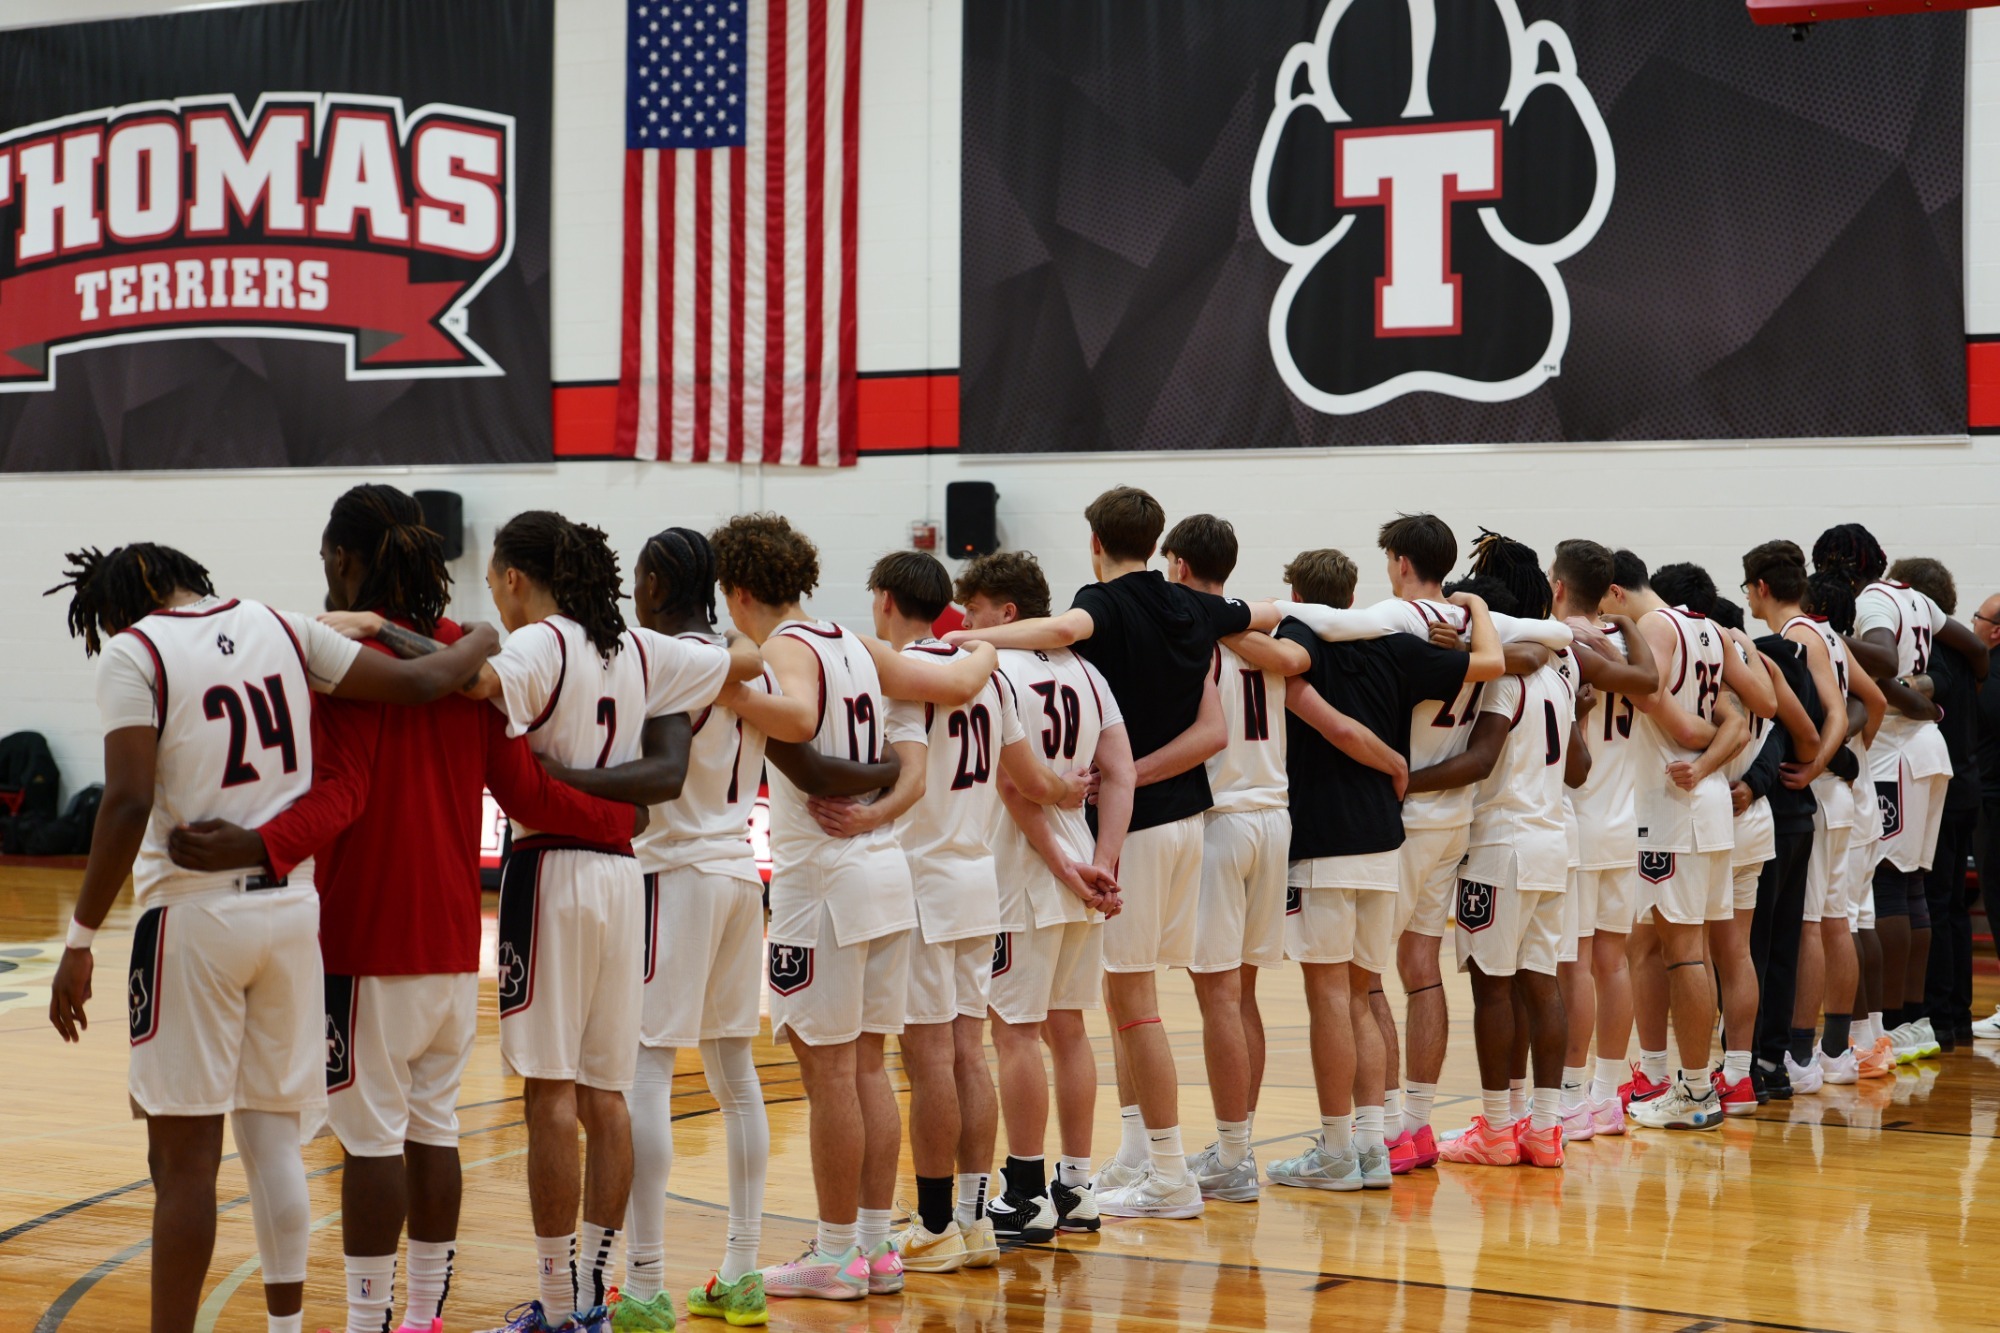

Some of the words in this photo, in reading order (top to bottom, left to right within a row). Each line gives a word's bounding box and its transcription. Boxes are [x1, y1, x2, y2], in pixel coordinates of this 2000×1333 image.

[0, 108, 503, 267] HOMAS
[1334, 119, 1502, 338] T
[74, 257, 330, 321] TERRIERS
[1543, 364, 1557, 373] TM
[202, 673, 298, 788] 24
[596, 696, 617, 769] 2
[843, 692, 879, 764] 12
[1028, 679, 1080, 759] 30
[1238, 669, 1270, 741] 11
[948, 703, 991, 791] 20
[1467, 894, 1481, 912] T
[778, 947, 793, 969] T
